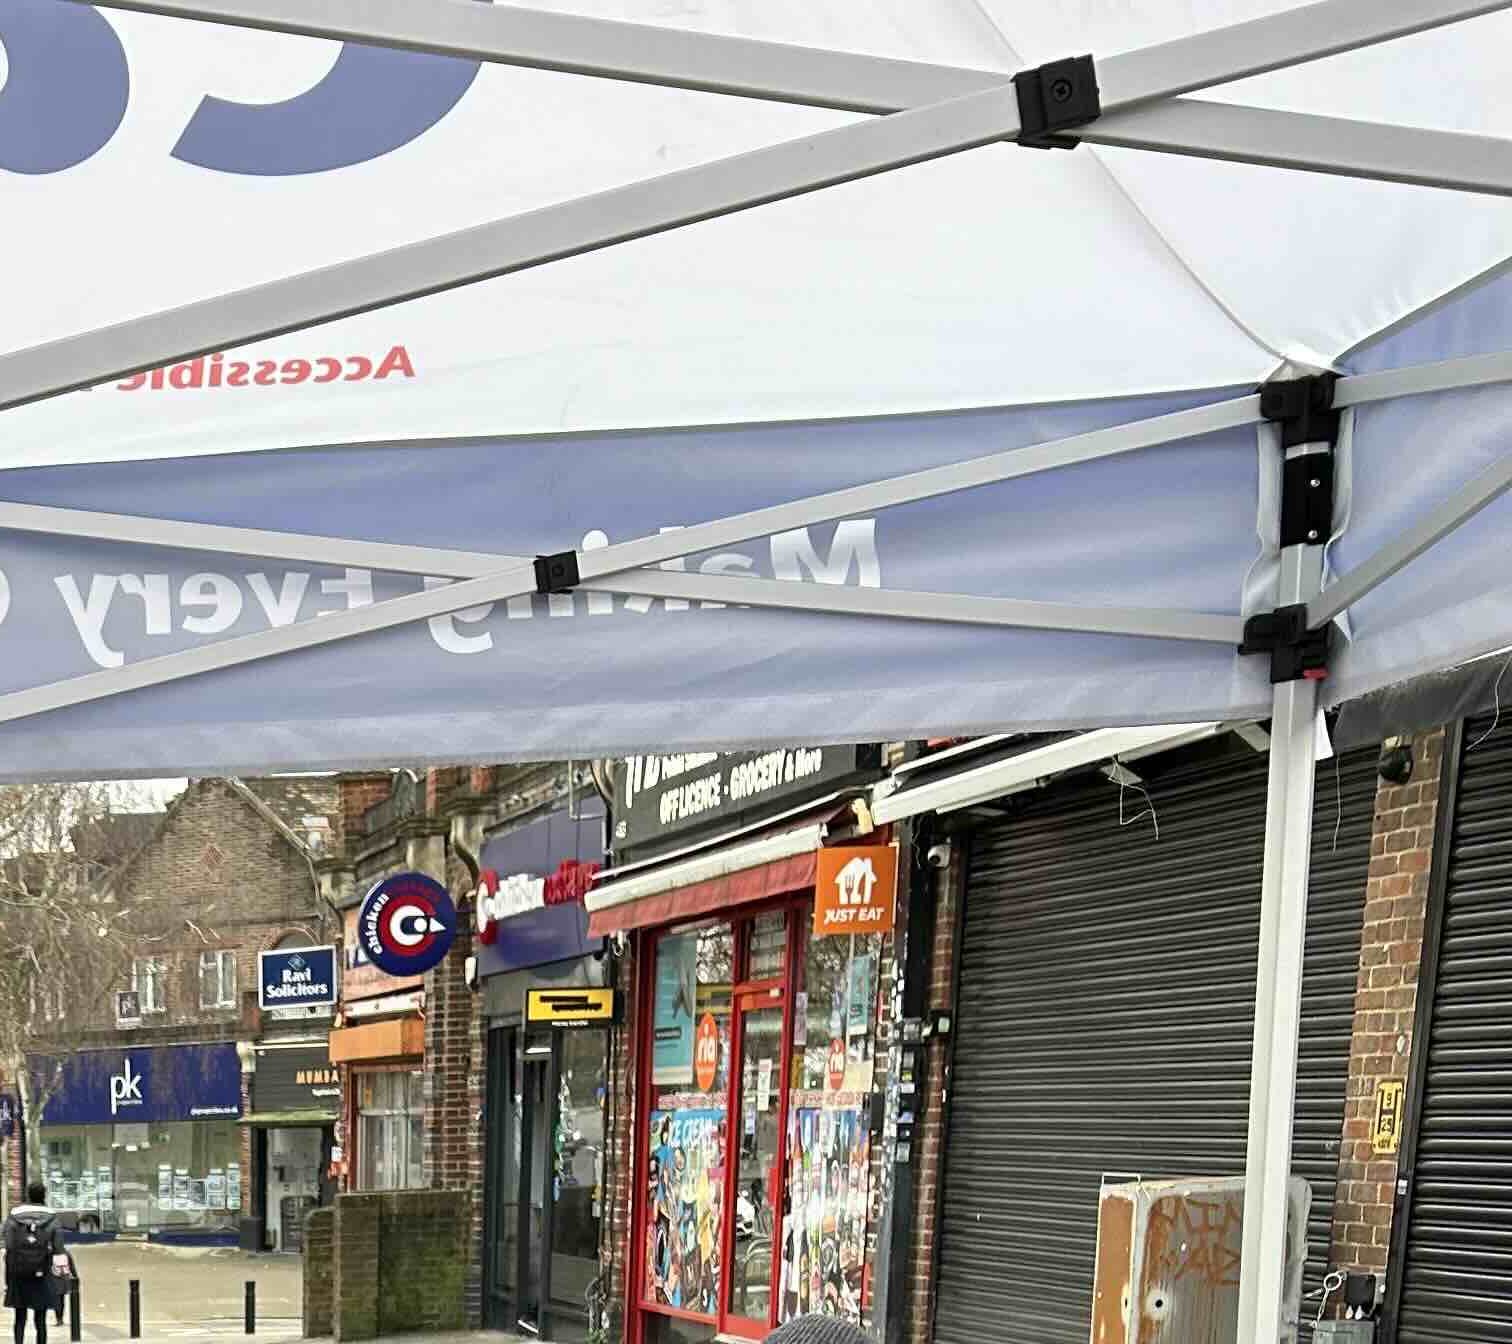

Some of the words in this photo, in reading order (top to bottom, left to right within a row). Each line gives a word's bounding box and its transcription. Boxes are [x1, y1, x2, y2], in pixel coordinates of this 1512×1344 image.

[730, 748, 786, 800] GROCERY
[824, 909, 855, 923] JUST
[859, 908, 885, 921] EAT
[266, 982, 328, 999] Solicitors
[110, 1058, 142, 1114] pk
